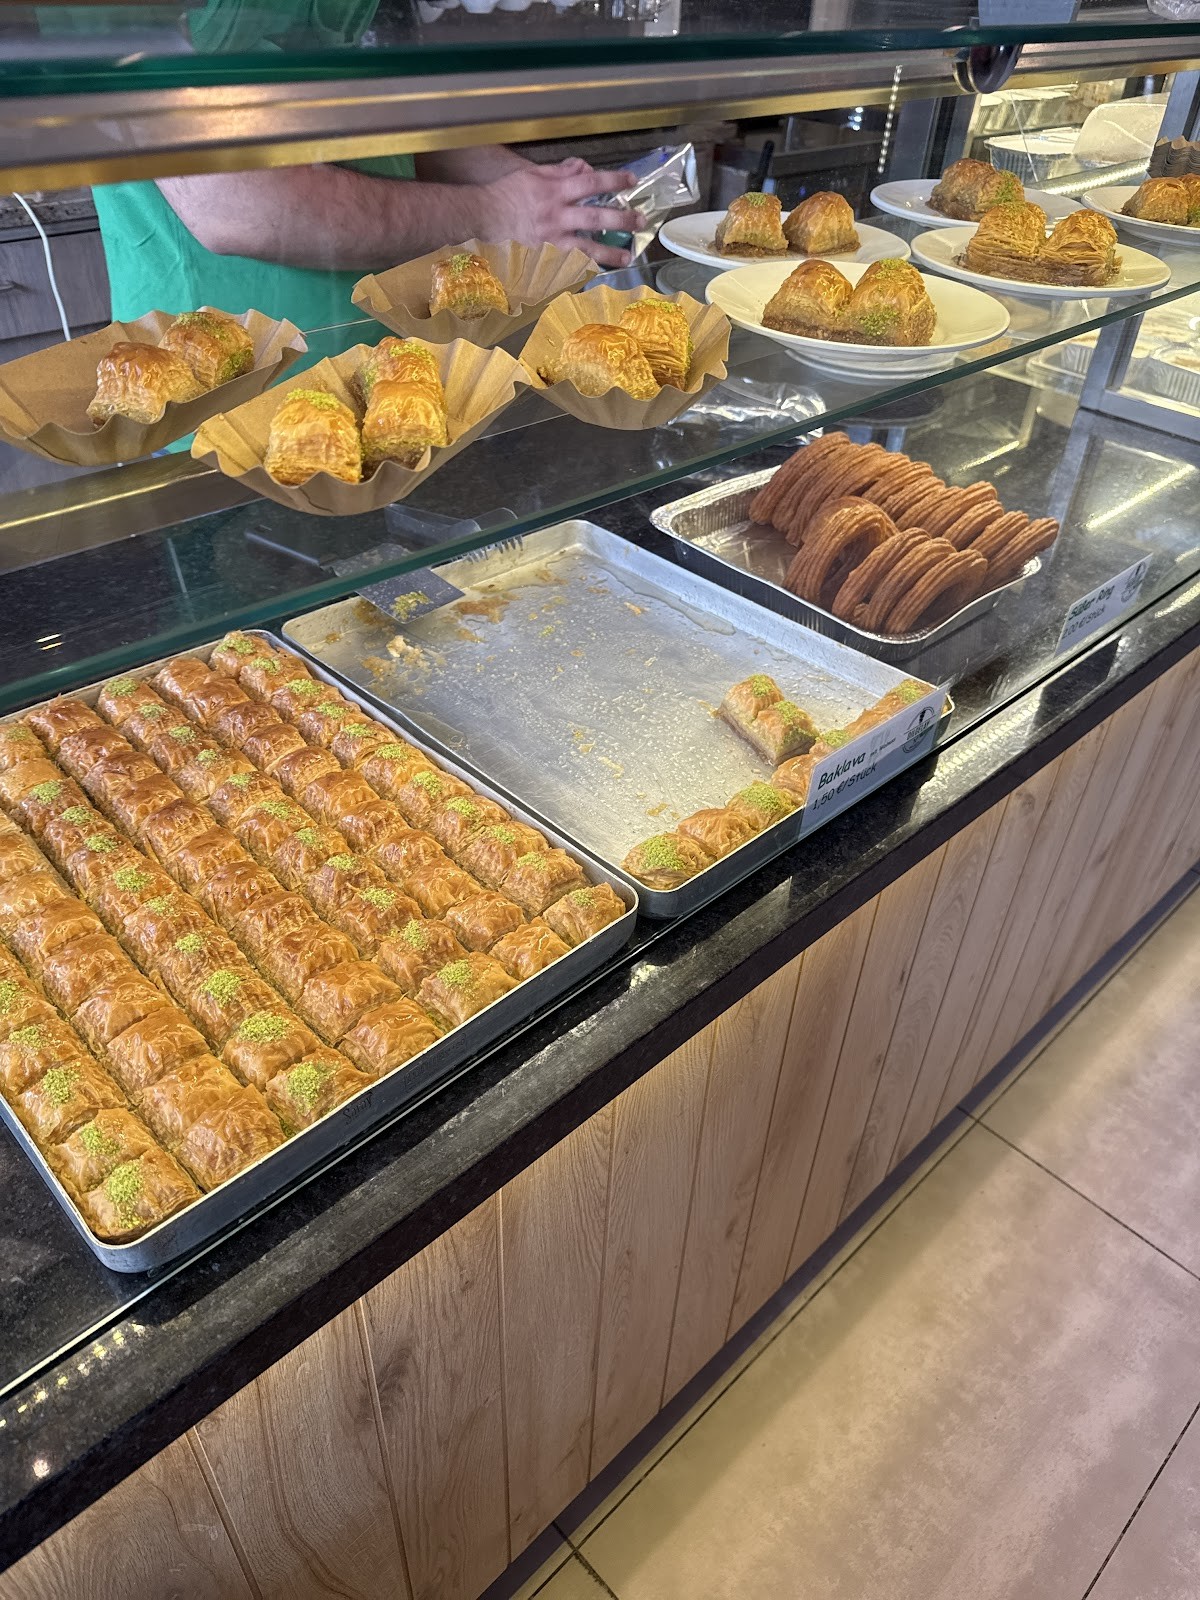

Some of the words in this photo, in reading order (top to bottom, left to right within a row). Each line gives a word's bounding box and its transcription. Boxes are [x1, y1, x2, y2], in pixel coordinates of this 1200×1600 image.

[812, 788, 835, 811] 1,50
[836, 762, 878, 795] €/Stück
[818, 752, 866, 790] Baklava
